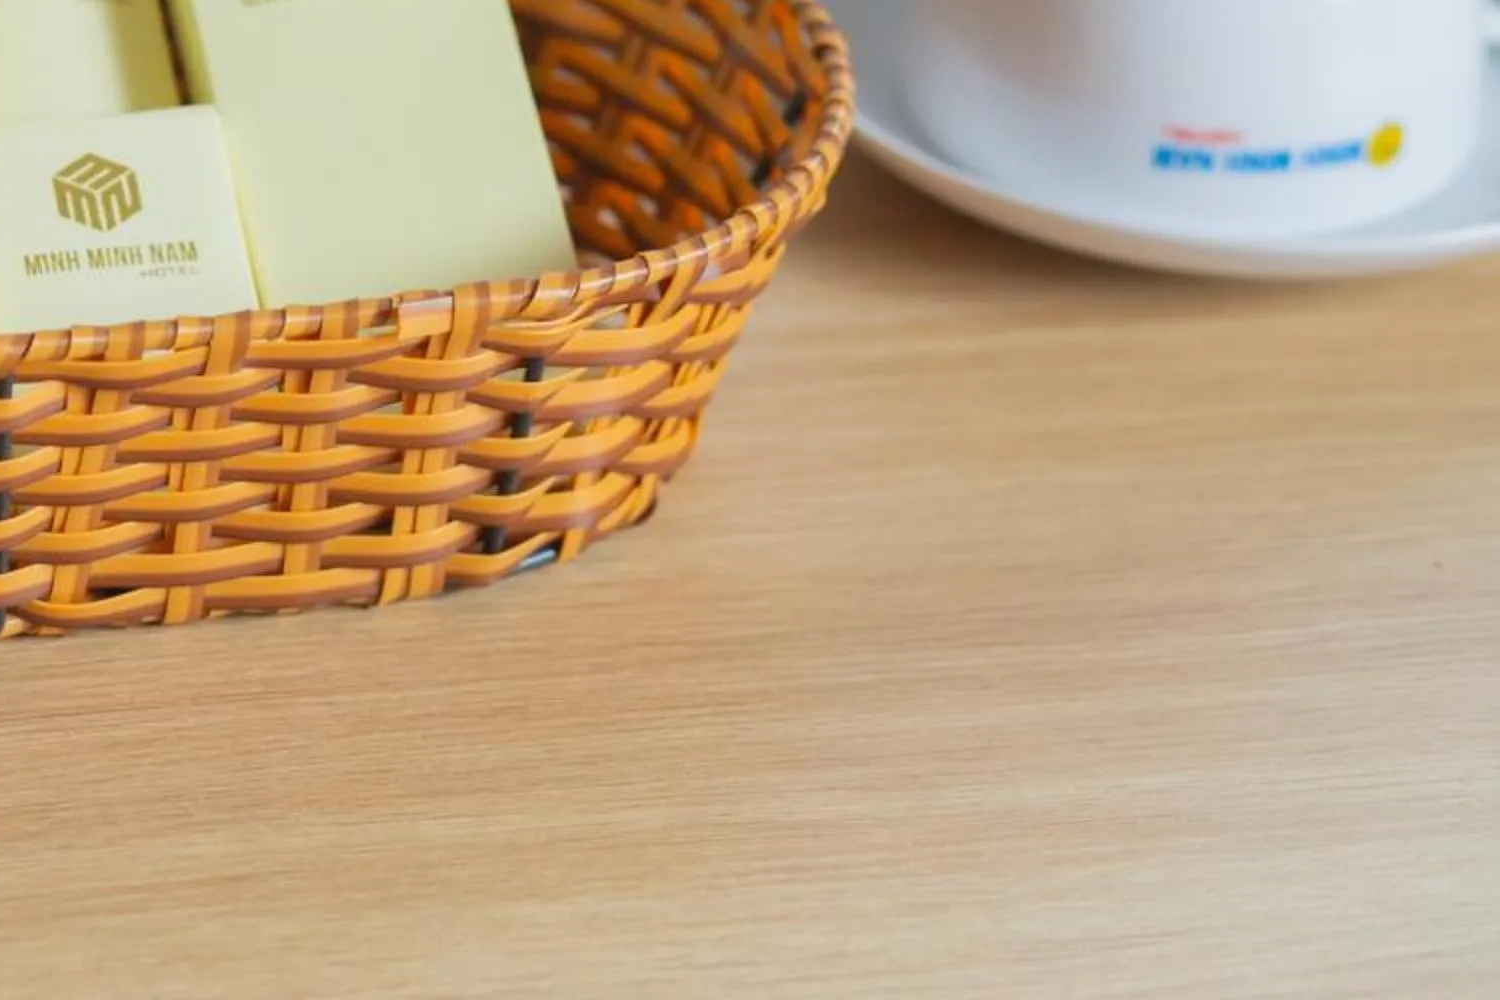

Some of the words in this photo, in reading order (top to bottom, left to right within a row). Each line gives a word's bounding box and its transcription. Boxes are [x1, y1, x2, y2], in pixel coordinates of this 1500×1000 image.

[24, 250, 80, 276] MINH
[86, 245, 143, 270] MINH
[149, 240, 197, 263] NAM
[138, 265, 199, 279] HOTEL
